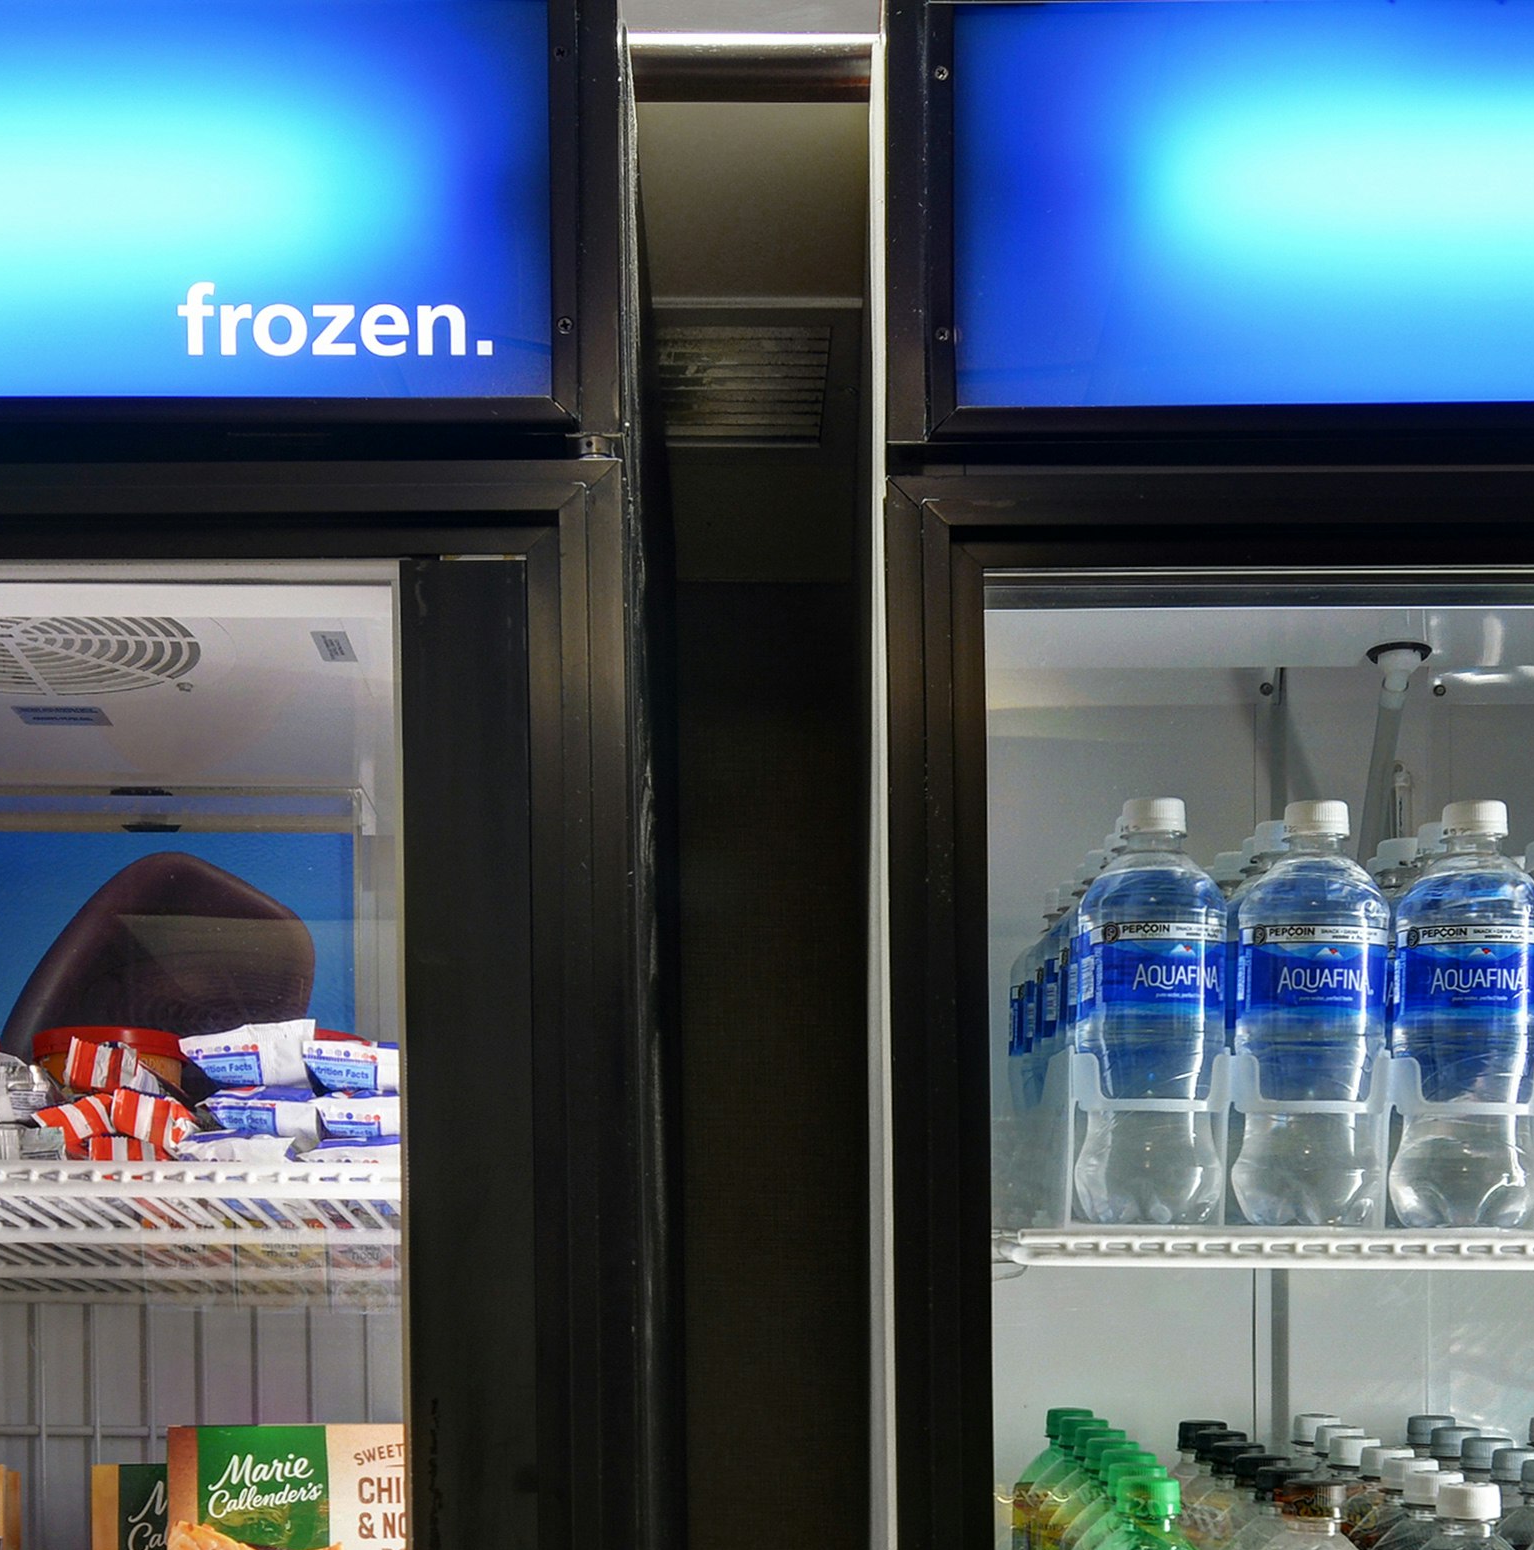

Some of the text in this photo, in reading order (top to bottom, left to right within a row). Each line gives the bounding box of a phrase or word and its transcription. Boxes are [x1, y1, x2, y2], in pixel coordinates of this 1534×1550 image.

[177, 281, 494, 357] frozen.
[1122, 923, 1170, 934] PEPCOIN
[1268, 926, 1315, 938] PEPCOIN
[1422, 927, 1468, 939] PEPCOIN
[1132, 963, 1221, 991] AQUAFINA
[1278, 966, 1374, 995] AQUAFINA
[208, 1454, 314, 1489] Marie
[207, 1482, 322, 1519] Callender's
